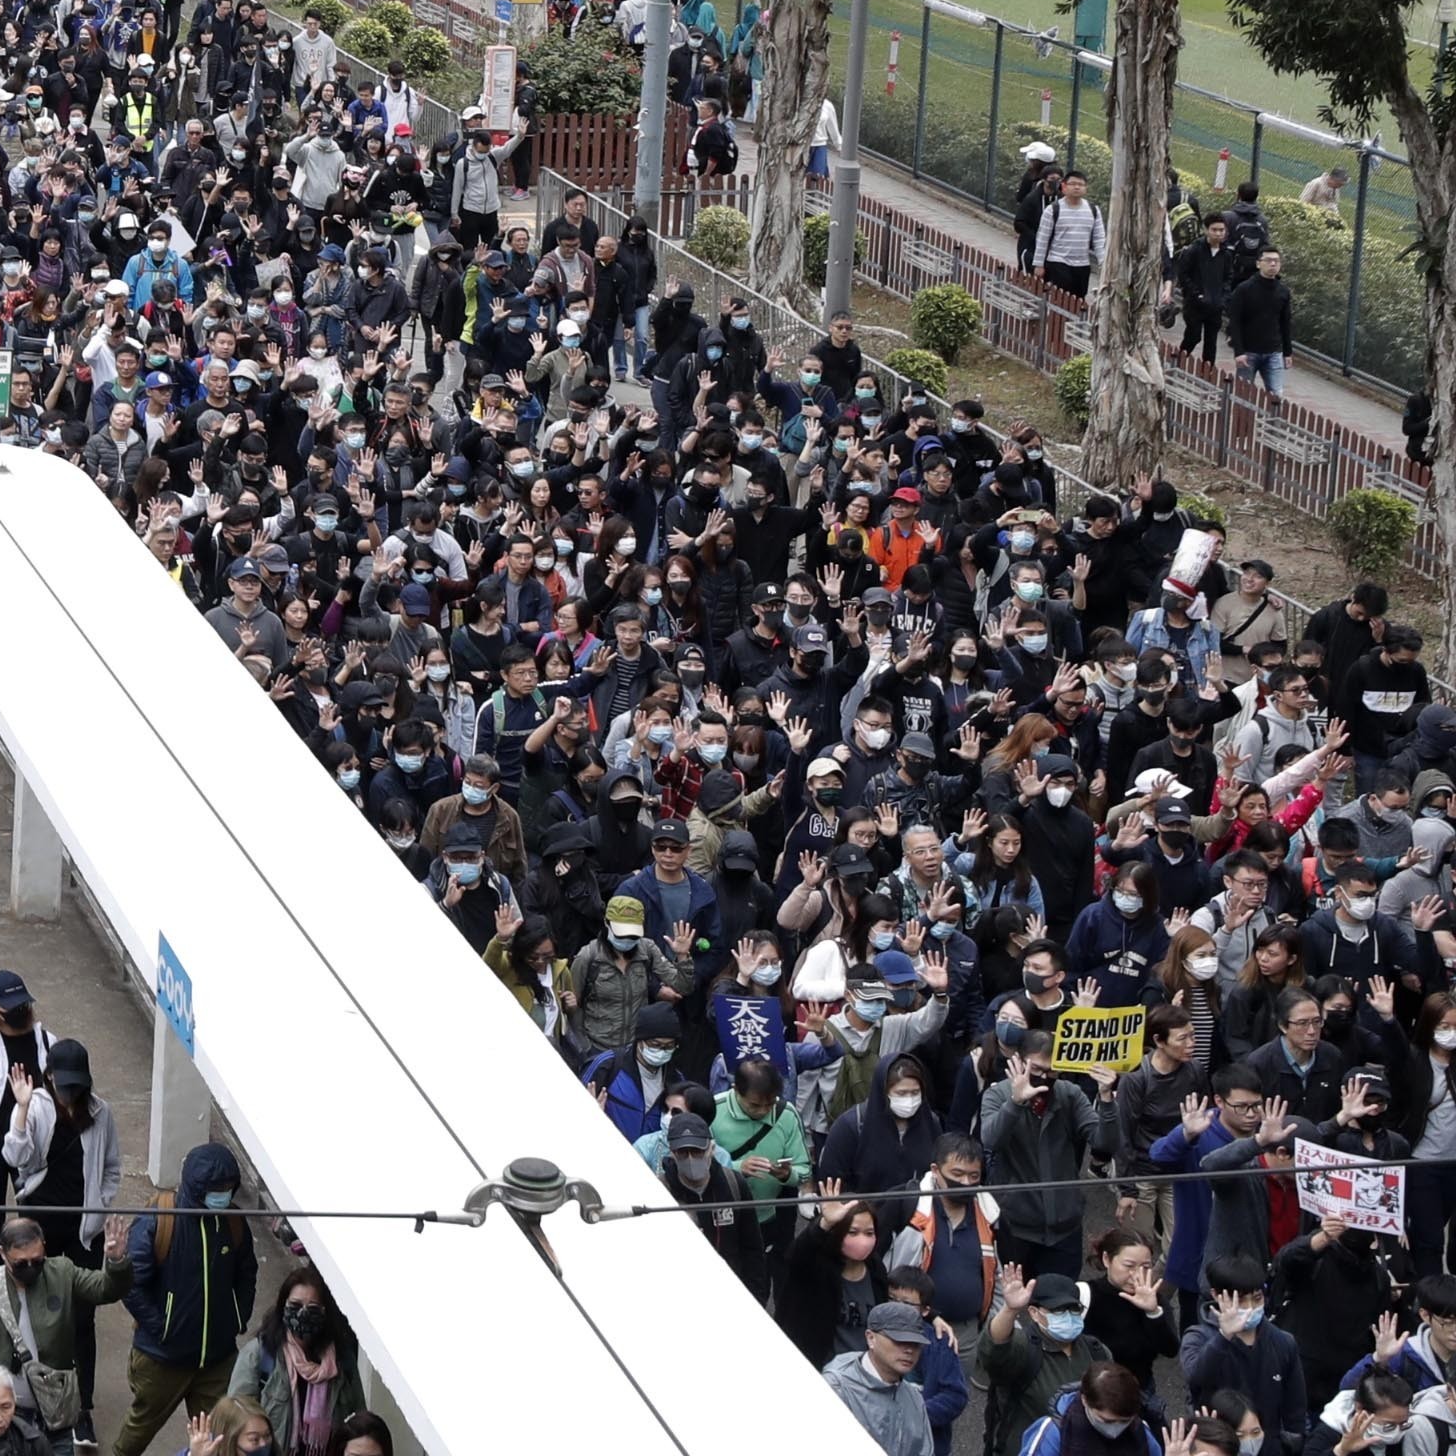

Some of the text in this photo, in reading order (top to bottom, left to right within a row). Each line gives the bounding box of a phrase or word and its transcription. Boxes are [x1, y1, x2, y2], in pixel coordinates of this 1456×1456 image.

[725, 998, 770, 1060] 天滅中共
[1061, 1013, 1144, 1039] STAND UP
[1057, 1041, 1094, 1062] FOR
